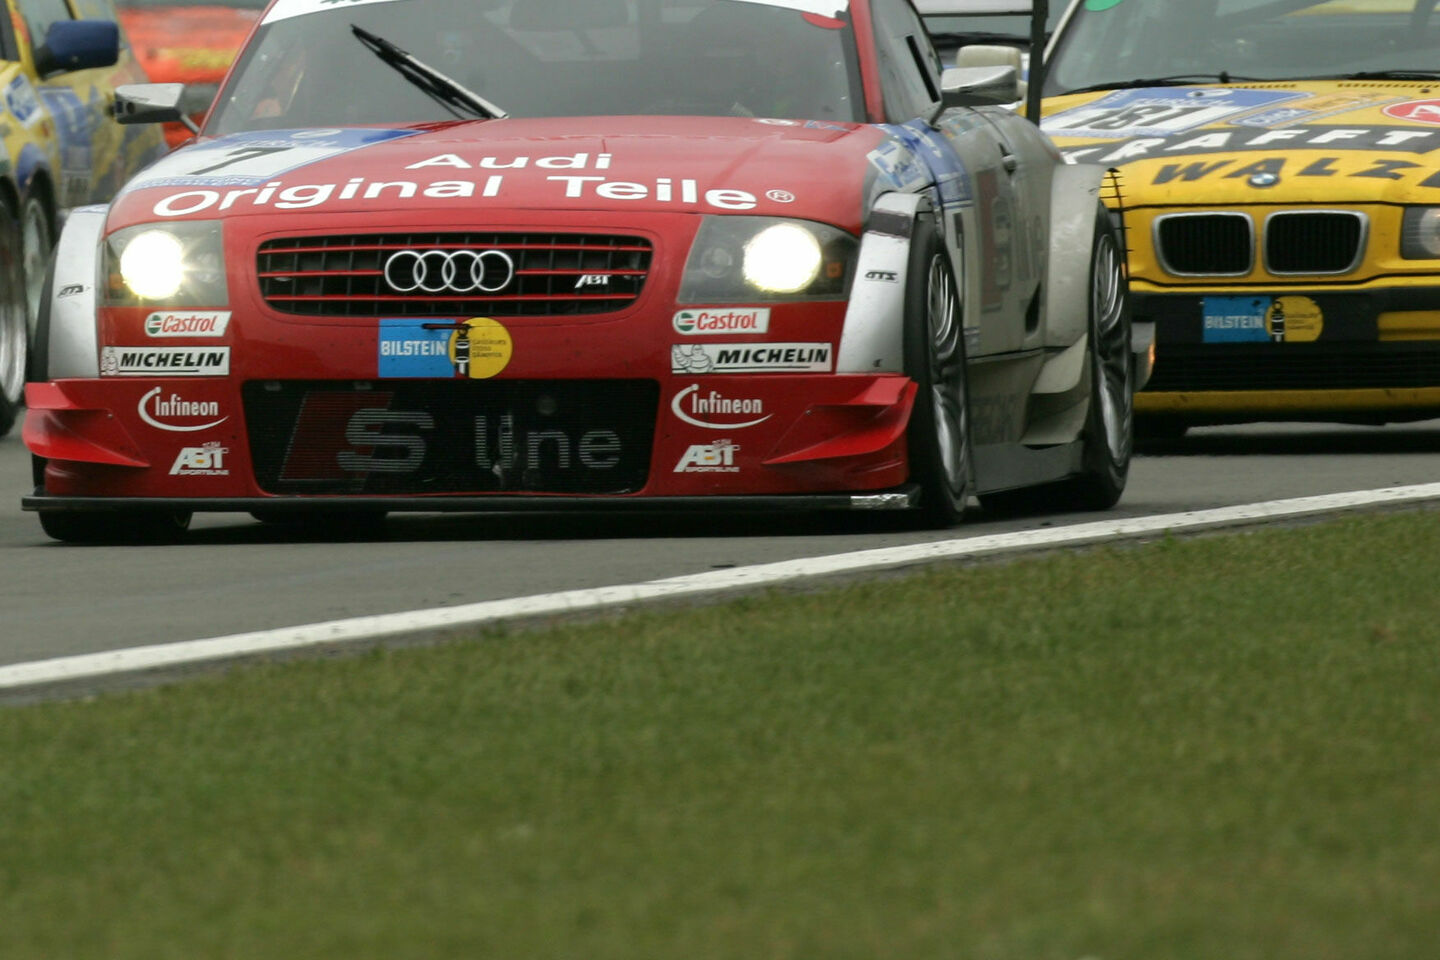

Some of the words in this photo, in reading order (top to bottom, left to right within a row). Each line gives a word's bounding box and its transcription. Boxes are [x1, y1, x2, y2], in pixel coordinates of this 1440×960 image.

[186, 146, 295, 176] 7
[404, 152, 613, 170] Audi
[1151, 157, 1440, 188] WALZ
[152, 174, 504, 218] Original
[546, 175, 759, 211] Teile
[574, 274, 612, 288] ABT
[162, 315, 218, 333] Castrol
[696, 312, 759, 330] Castrol
[1205, 315, 1264, 329] BILSTEIN
[380, 340, 447, 356] BILSTEIN
[715, 348, 829, 365] MICHELIN
[120, 352, 225, 368] MICHELIN
[154, 393, 219, 417] Infineon
[691, 390, 763, 414] Infineon
[474, 414, 624, 471] line
[168, 446, 230, 476] ABT
[673, 443, 741, 473] ABT
